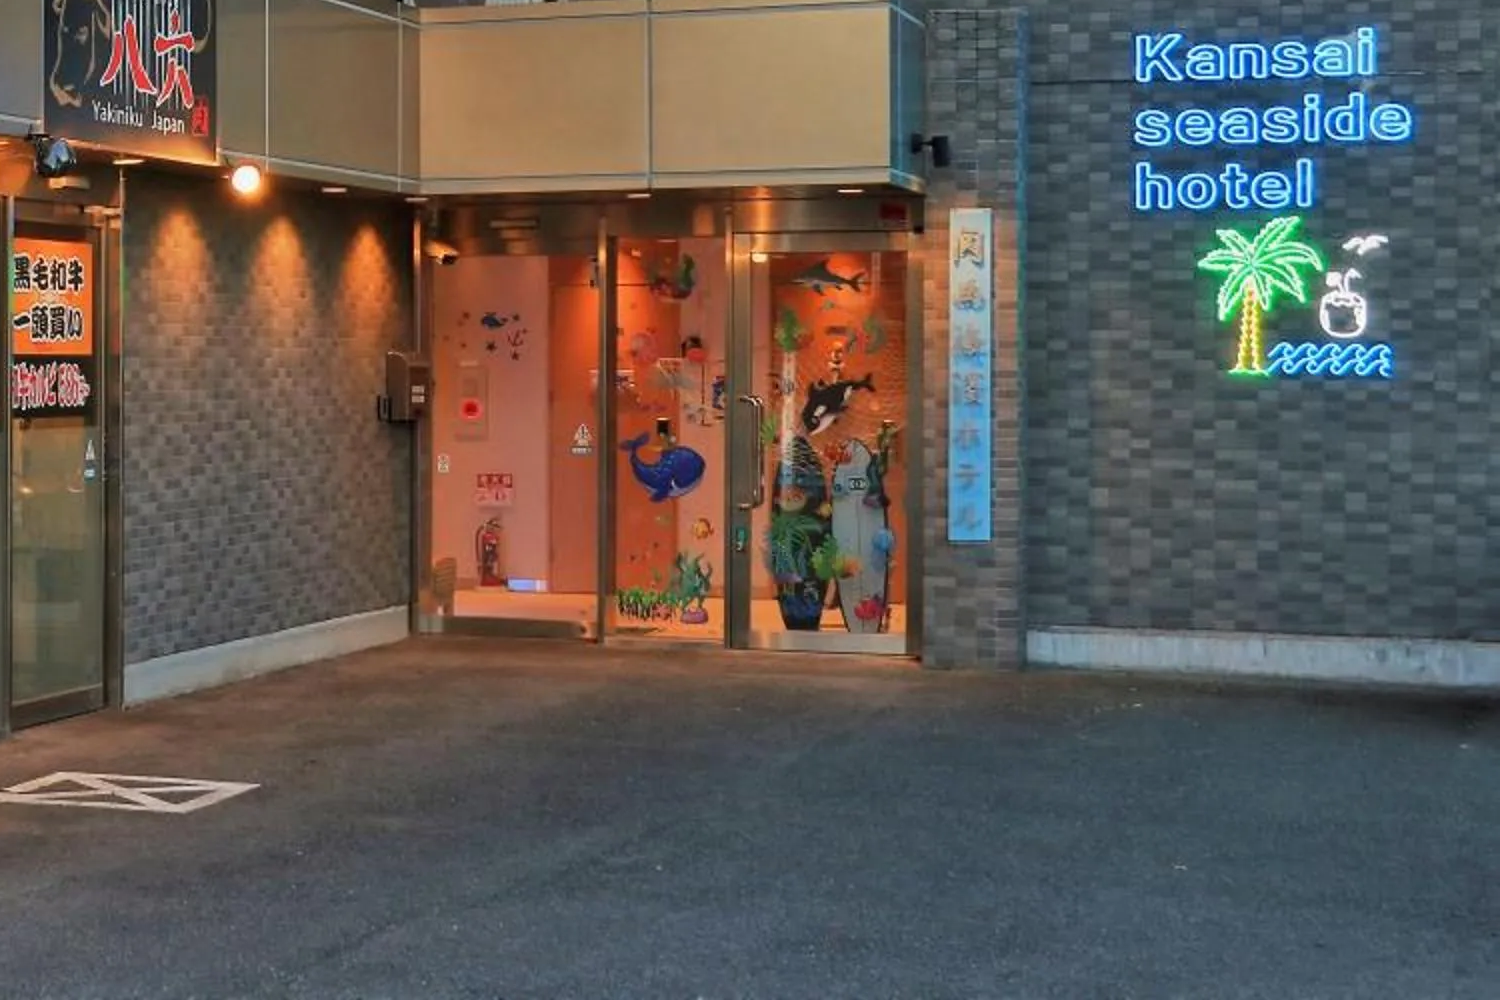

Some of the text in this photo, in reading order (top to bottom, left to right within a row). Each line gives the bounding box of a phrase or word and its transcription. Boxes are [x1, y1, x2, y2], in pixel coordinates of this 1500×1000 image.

[1134, 27, 1377, 83] Kansai
[92, 100, 144, 128] Yakiniku
[151, 112, 185, 135] Japan
[1133, 92, 1413, 147] seaside
[1134, 158, 1315, 210] hotel
[13, 255, 84, 293] 黒毛和牛
[13, 306, 84, 343] 一頭買い
